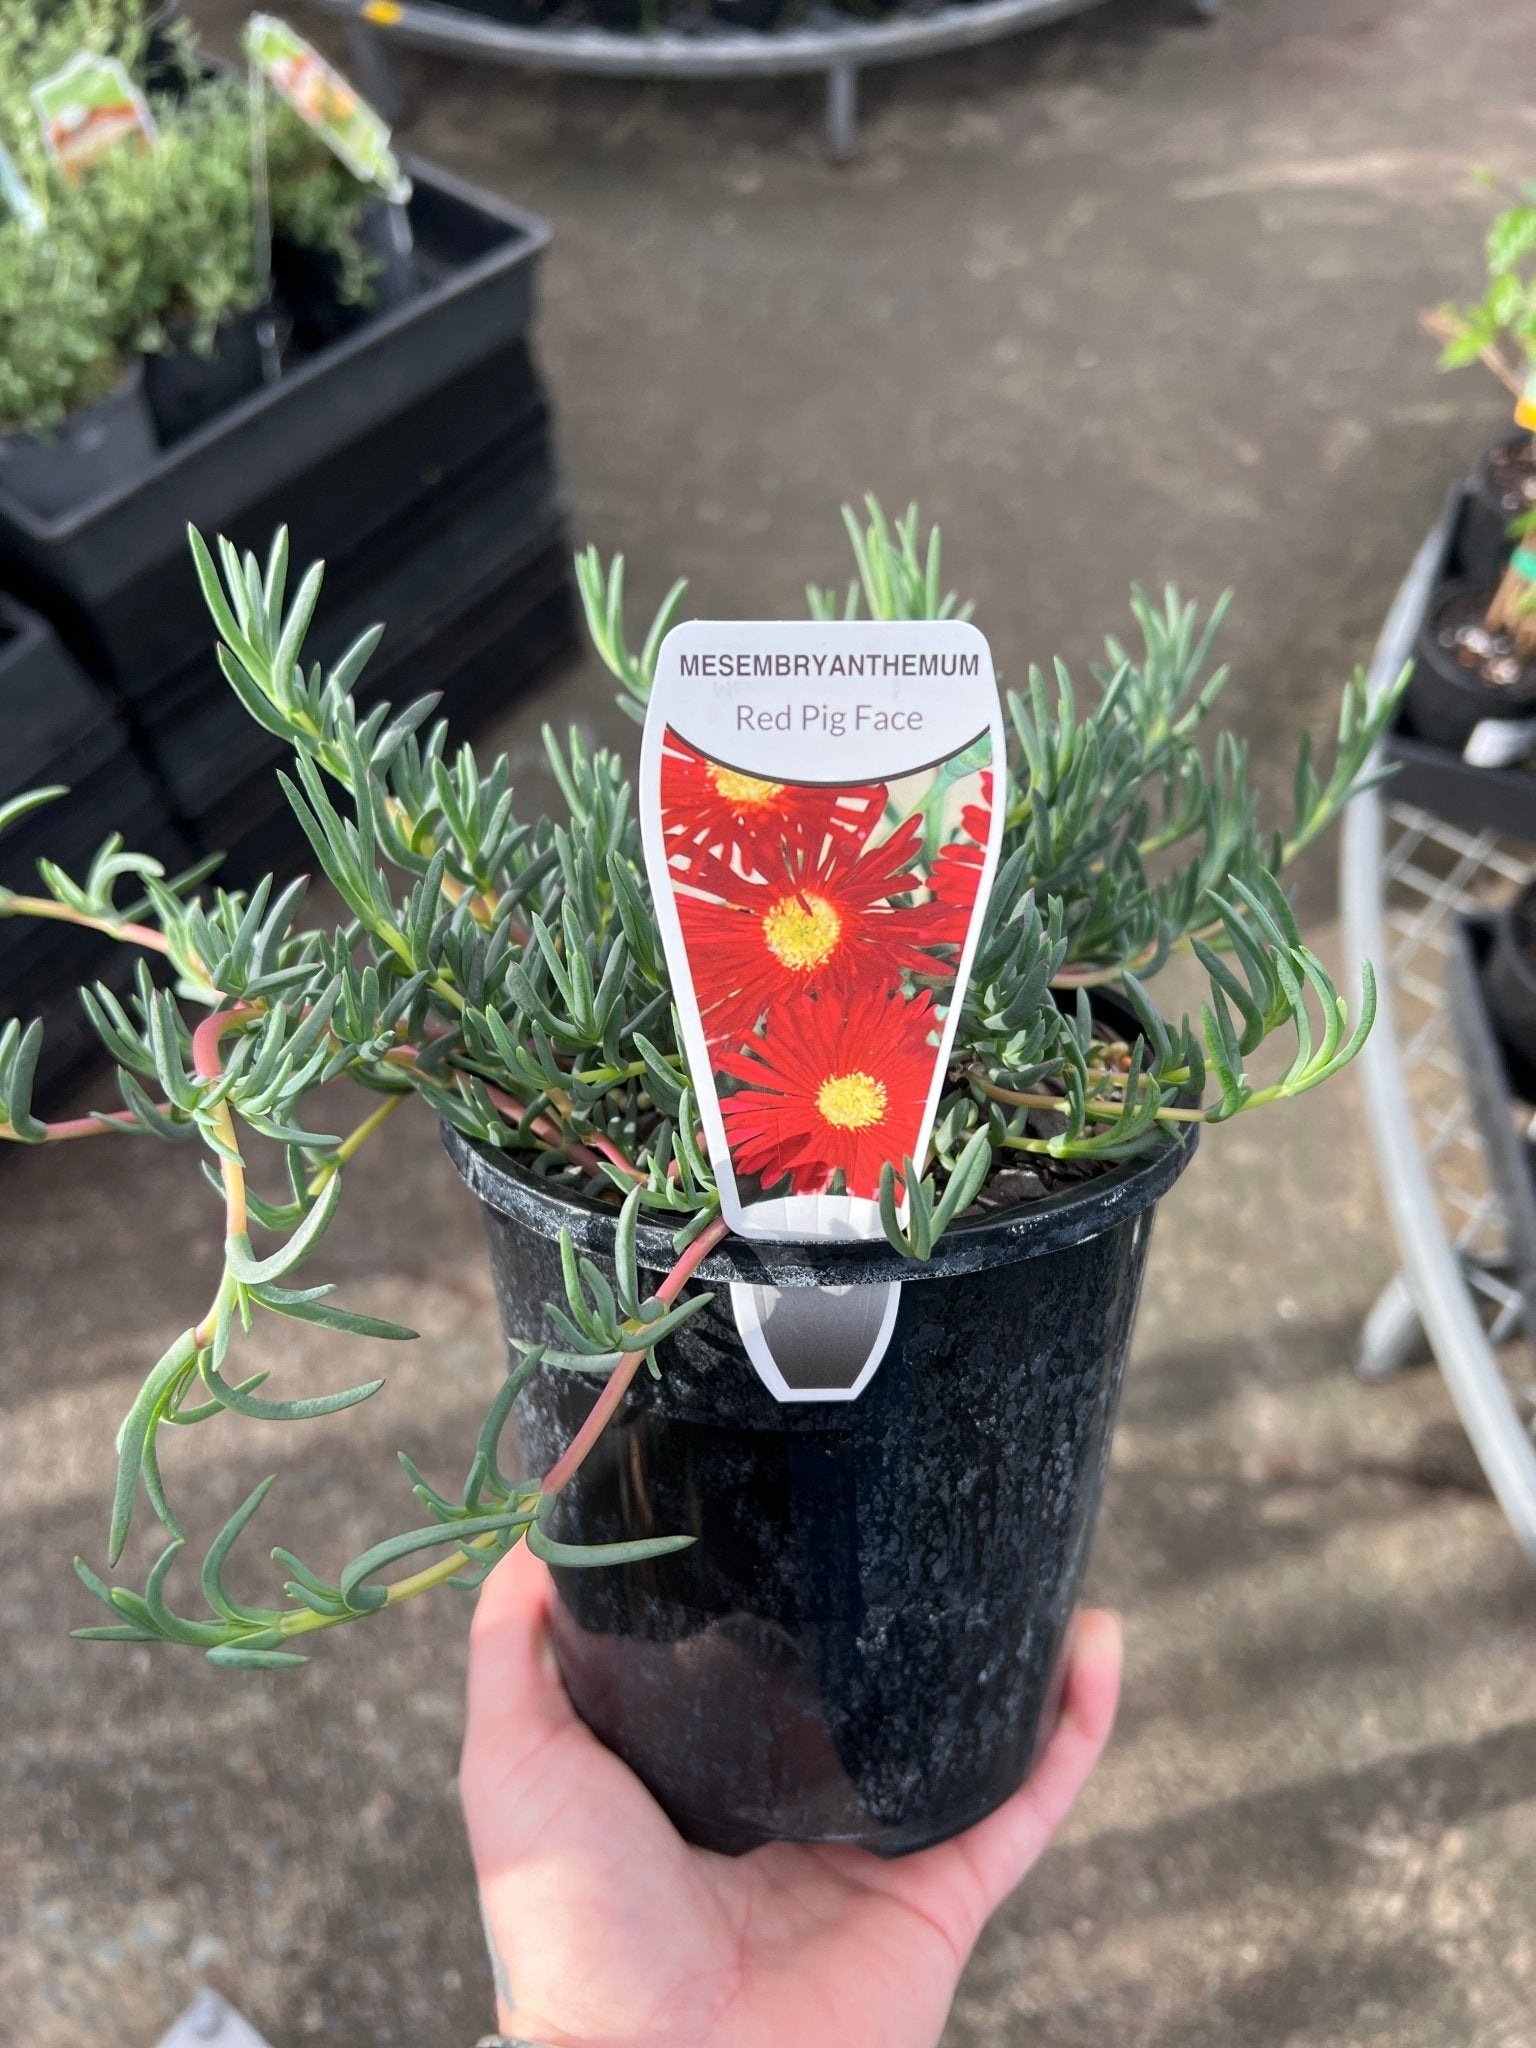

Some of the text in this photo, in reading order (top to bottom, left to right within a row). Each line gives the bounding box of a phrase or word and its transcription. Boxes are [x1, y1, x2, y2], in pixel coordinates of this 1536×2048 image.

[680, 654, 979, 676] MESEMBRYANTHEMUM
[737, 705, 923, 736] Red Pig Face
